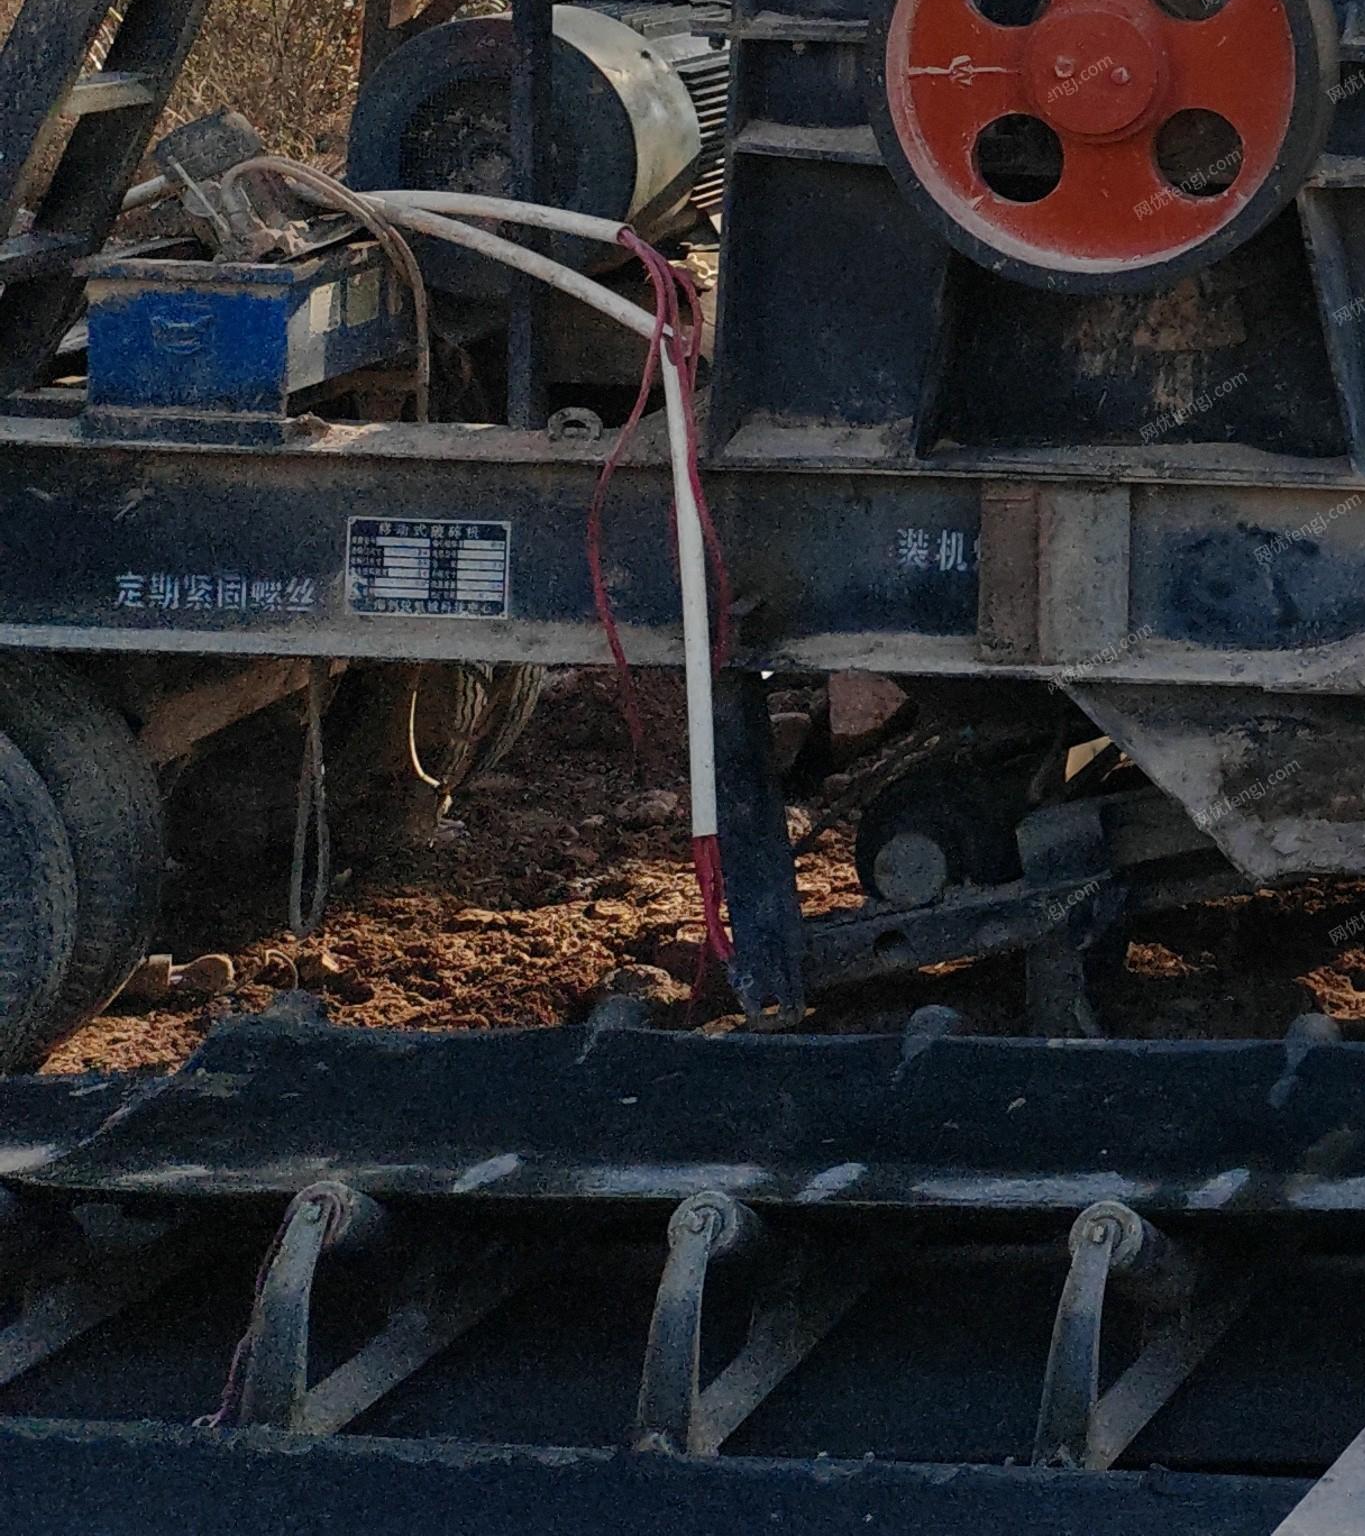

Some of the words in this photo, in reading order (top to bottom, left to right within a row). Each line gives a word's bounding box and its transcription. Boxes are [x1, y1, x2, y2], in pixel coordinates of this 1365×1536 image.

[897, 528, 982, 571] 装机
[114, 571, 315, 610] 定期紧固螺丝
